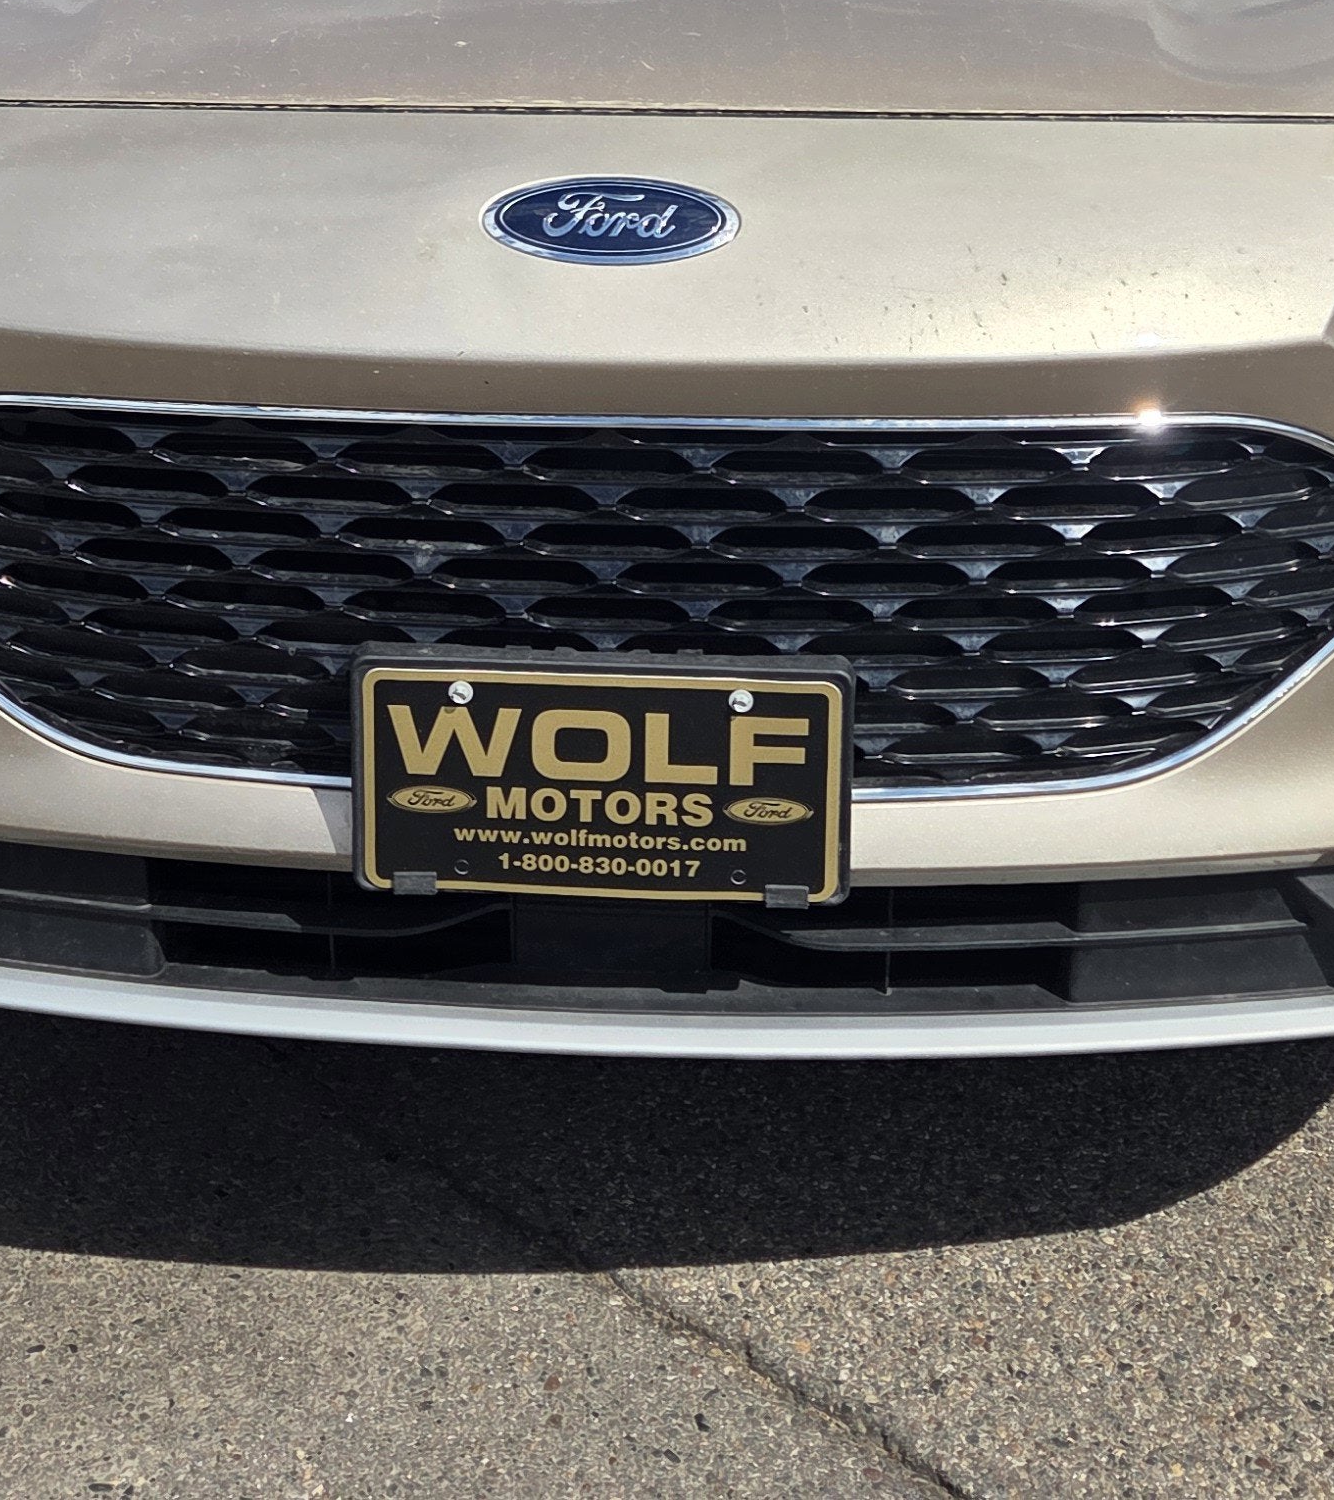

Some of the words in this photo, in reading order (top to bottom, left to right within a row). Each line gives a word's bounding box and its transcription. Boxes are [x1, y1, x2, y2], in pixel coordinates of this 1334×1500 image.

[542, 192, 678, 238] Ford
[387, 704, 810, 786] WOLF
[486, 786, 714, 827] MOTORS
[453, 827, 747, 852] www.wolfmotors.com
[498, 853, 701, 877] 1-800-830-0017
